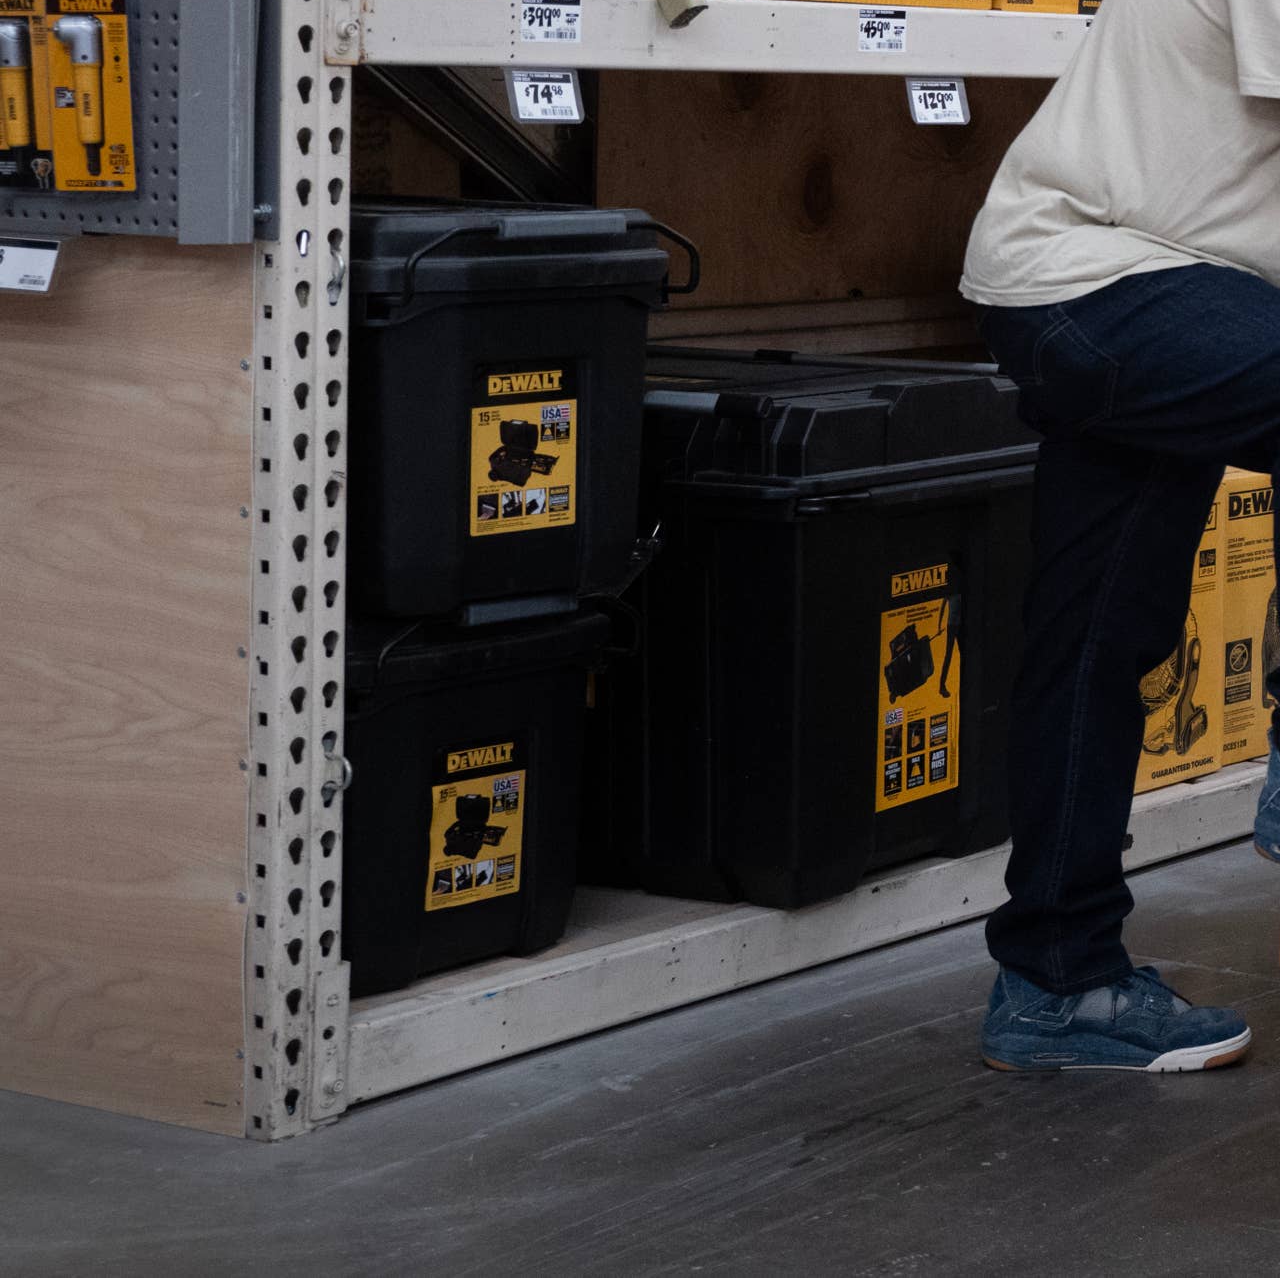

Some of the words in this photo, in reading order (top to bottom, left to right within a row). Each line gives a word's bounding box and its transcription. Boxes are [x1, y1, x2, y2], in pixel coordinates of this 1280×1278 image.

[488, 373, 562, 394] DEWALT
[479, 411, 490, 422] 15
[541, 408, 561, 420] USA
[1228, 490, 1273, 518] DEW
[891, 566, 948, 597] DEWALT
[886, 711, 898, 724] USA
[447, 744, 513, 772] DEWALT
[1151, 763, 1191, 779] GUARANTEED
[494, 779, 512, 792] USA
